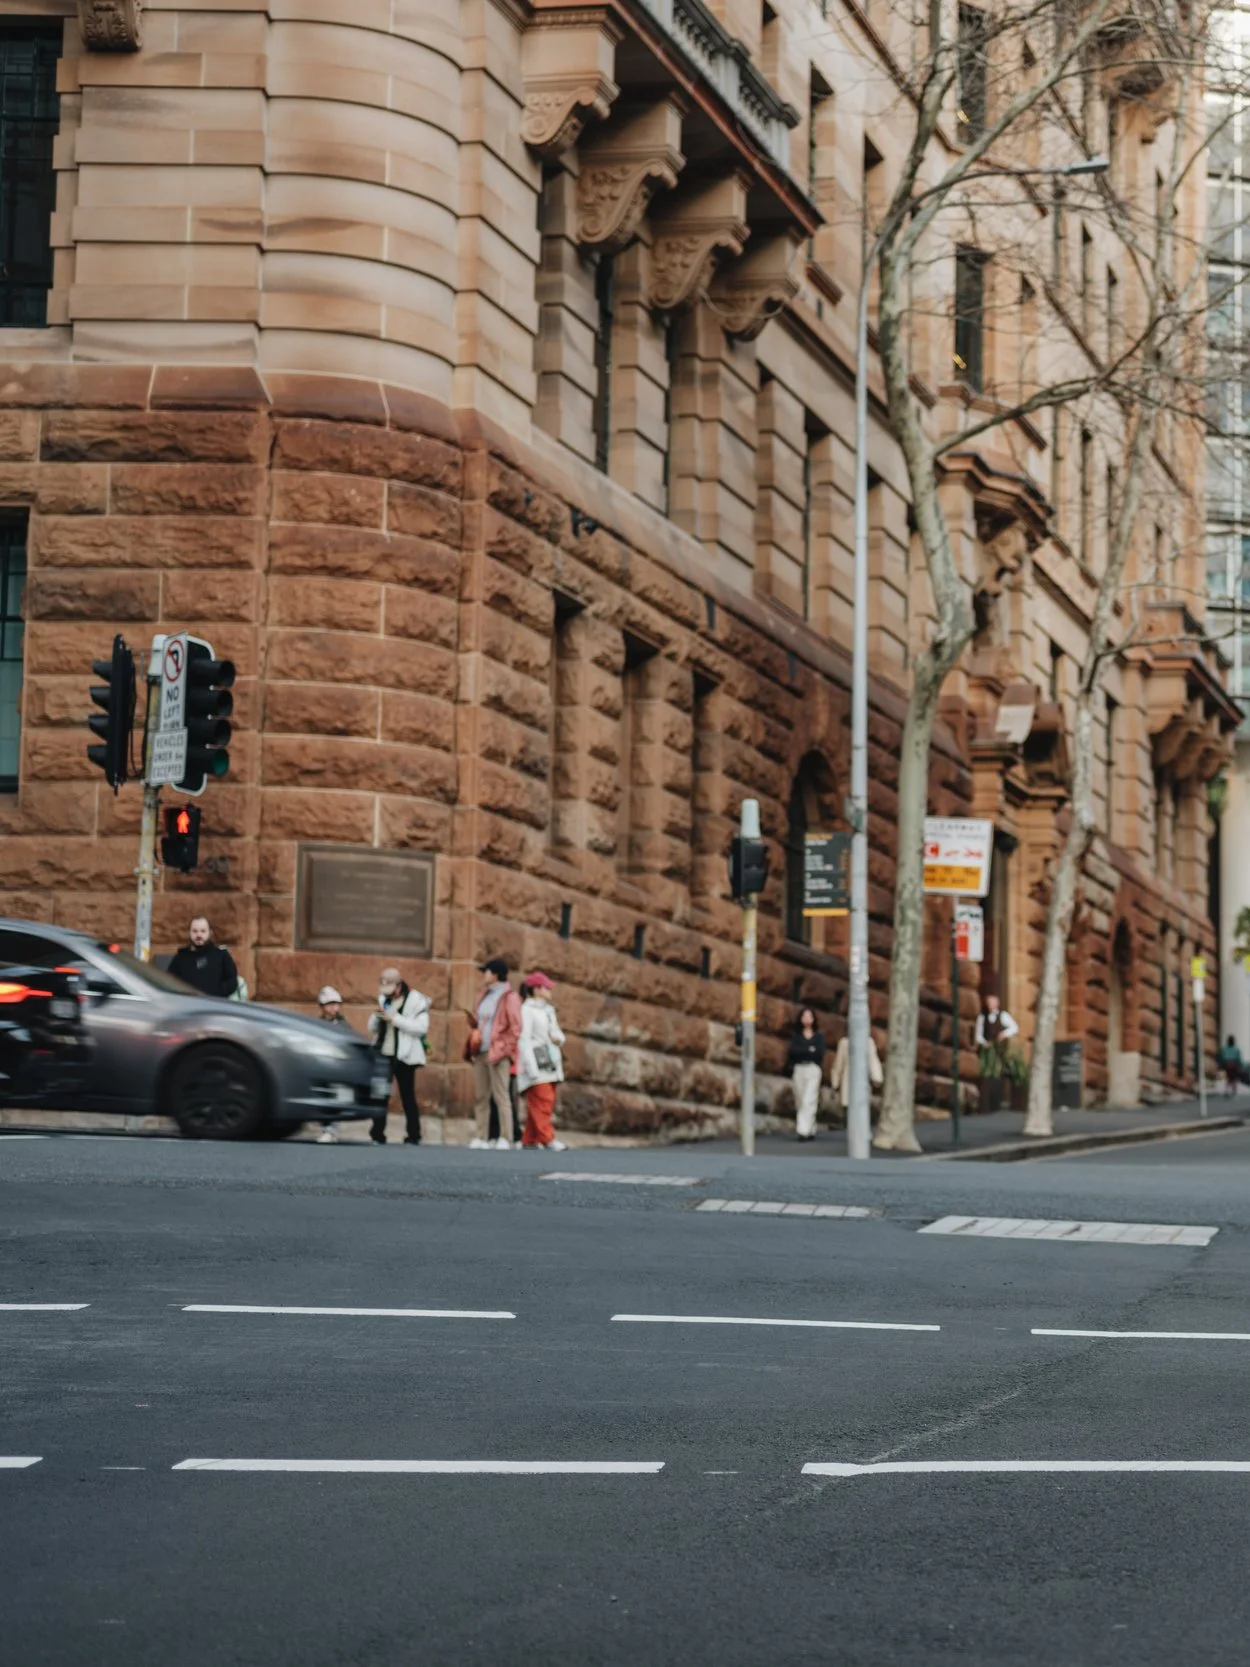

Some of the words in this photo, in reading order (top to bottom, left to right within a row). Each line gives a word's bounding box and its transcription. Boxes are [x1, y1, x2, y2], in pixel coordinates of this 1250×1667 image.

[166, 686, 179, 703] NO
[164, 704, 180, 719] LEFT
[156, 734, 183, 748] VEHICLES
[154, 751, 172, 762] UNDER
[153, 764, 181, 778] EXCEPTED
